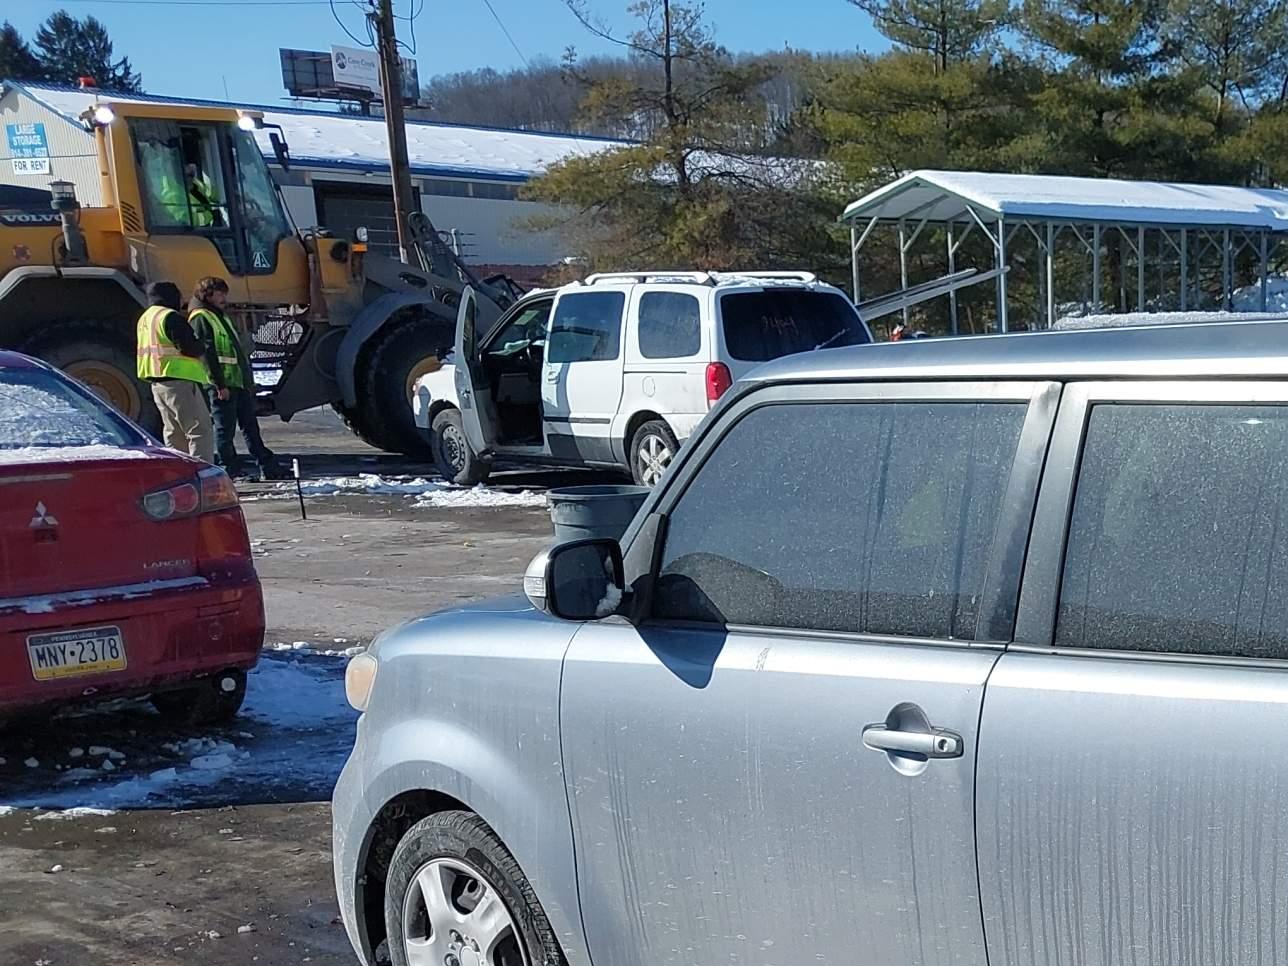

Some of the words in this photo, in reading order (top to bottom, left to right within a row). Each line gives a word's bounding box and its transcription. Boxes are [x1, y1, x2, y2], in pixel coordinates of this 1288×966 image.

[12, 134, 42, 146] STORAGE
[14, 160, 28, 170] FOR
[30, 160, 47, 170] RENT
[3, 214, 63, 222] VOLVO
[143, 559, 191, 569] LANCER
